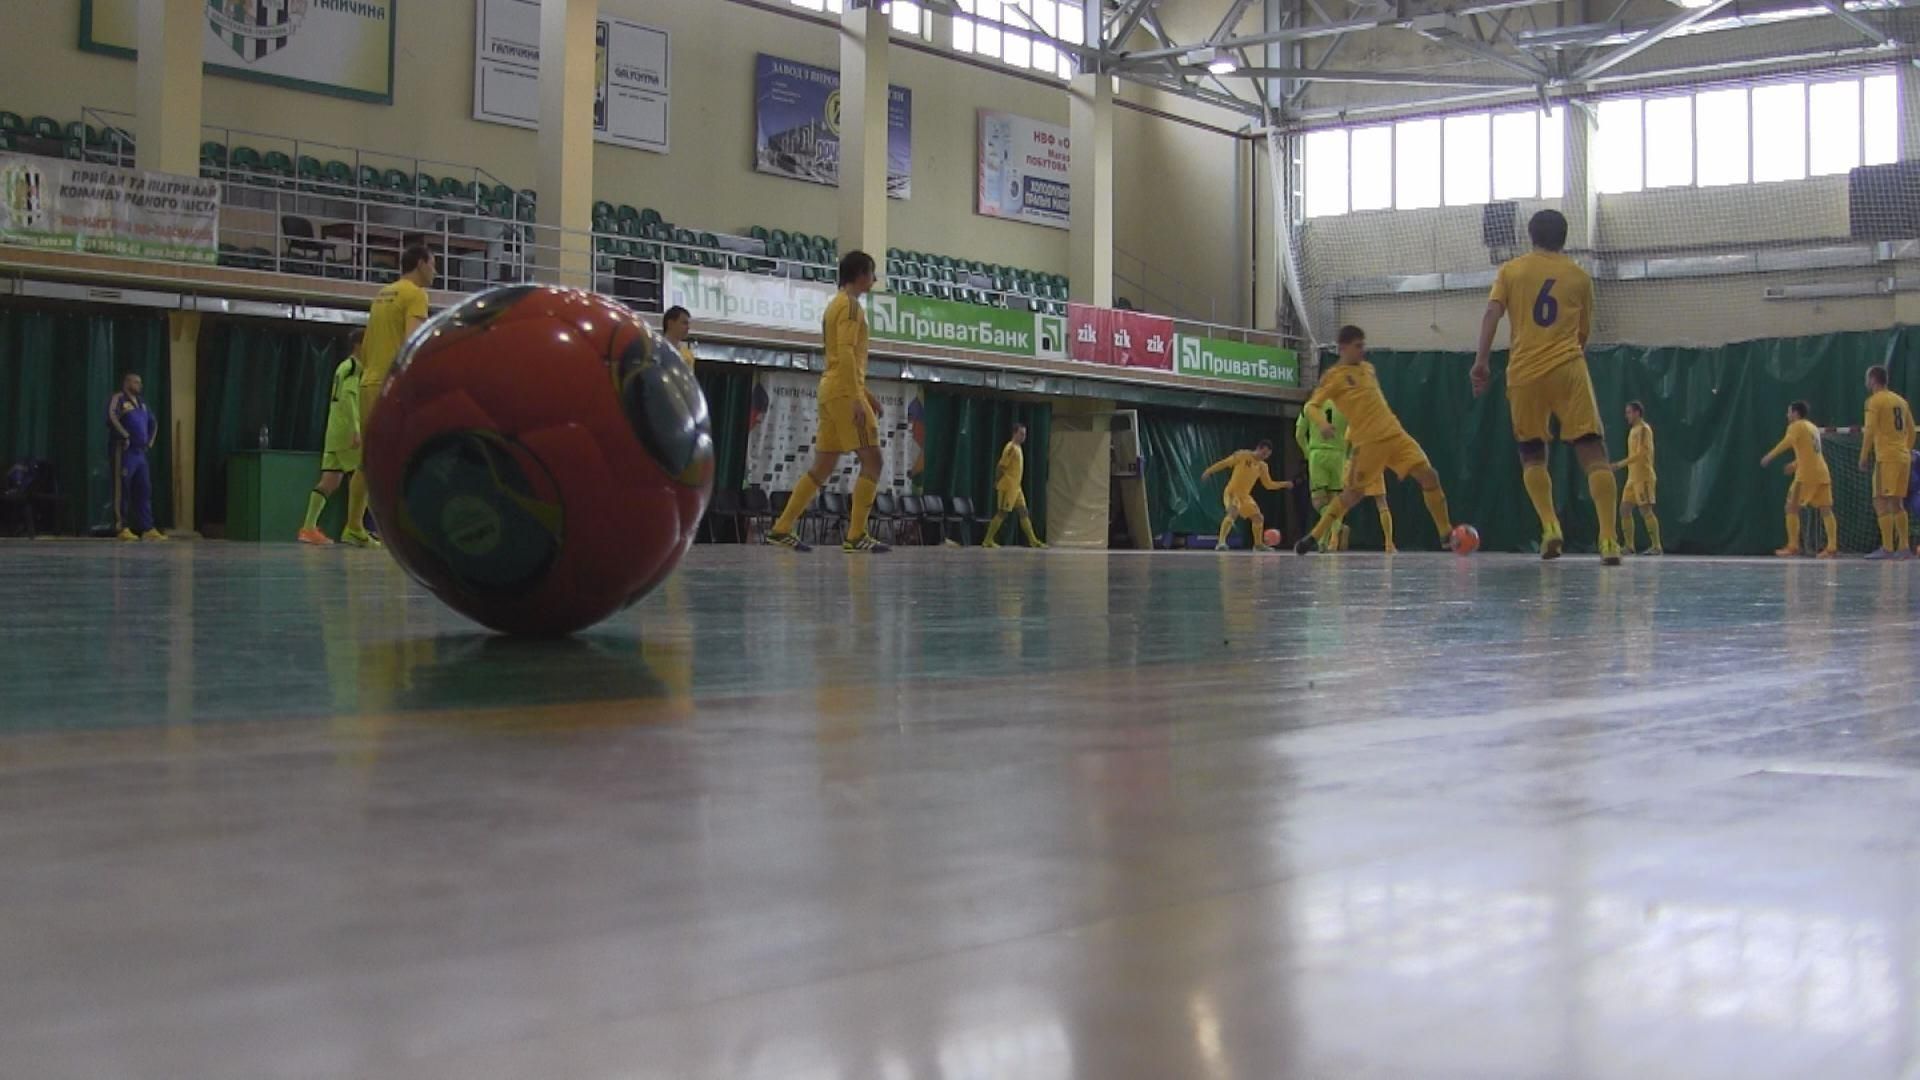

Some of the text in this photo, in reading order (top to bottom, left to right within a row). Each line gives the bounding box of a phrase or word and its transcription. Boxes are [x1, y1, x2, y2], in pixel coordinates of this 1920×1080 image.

[1532, 279, 1557, 328] 6
[900, 312, 1029, 349] ПриватБанк
[1077, 323, 1164, 354] zik zik zik
[1202, 352, 1294, 382] ПриватБанк
[1893, 406, 1904, 431] 8
